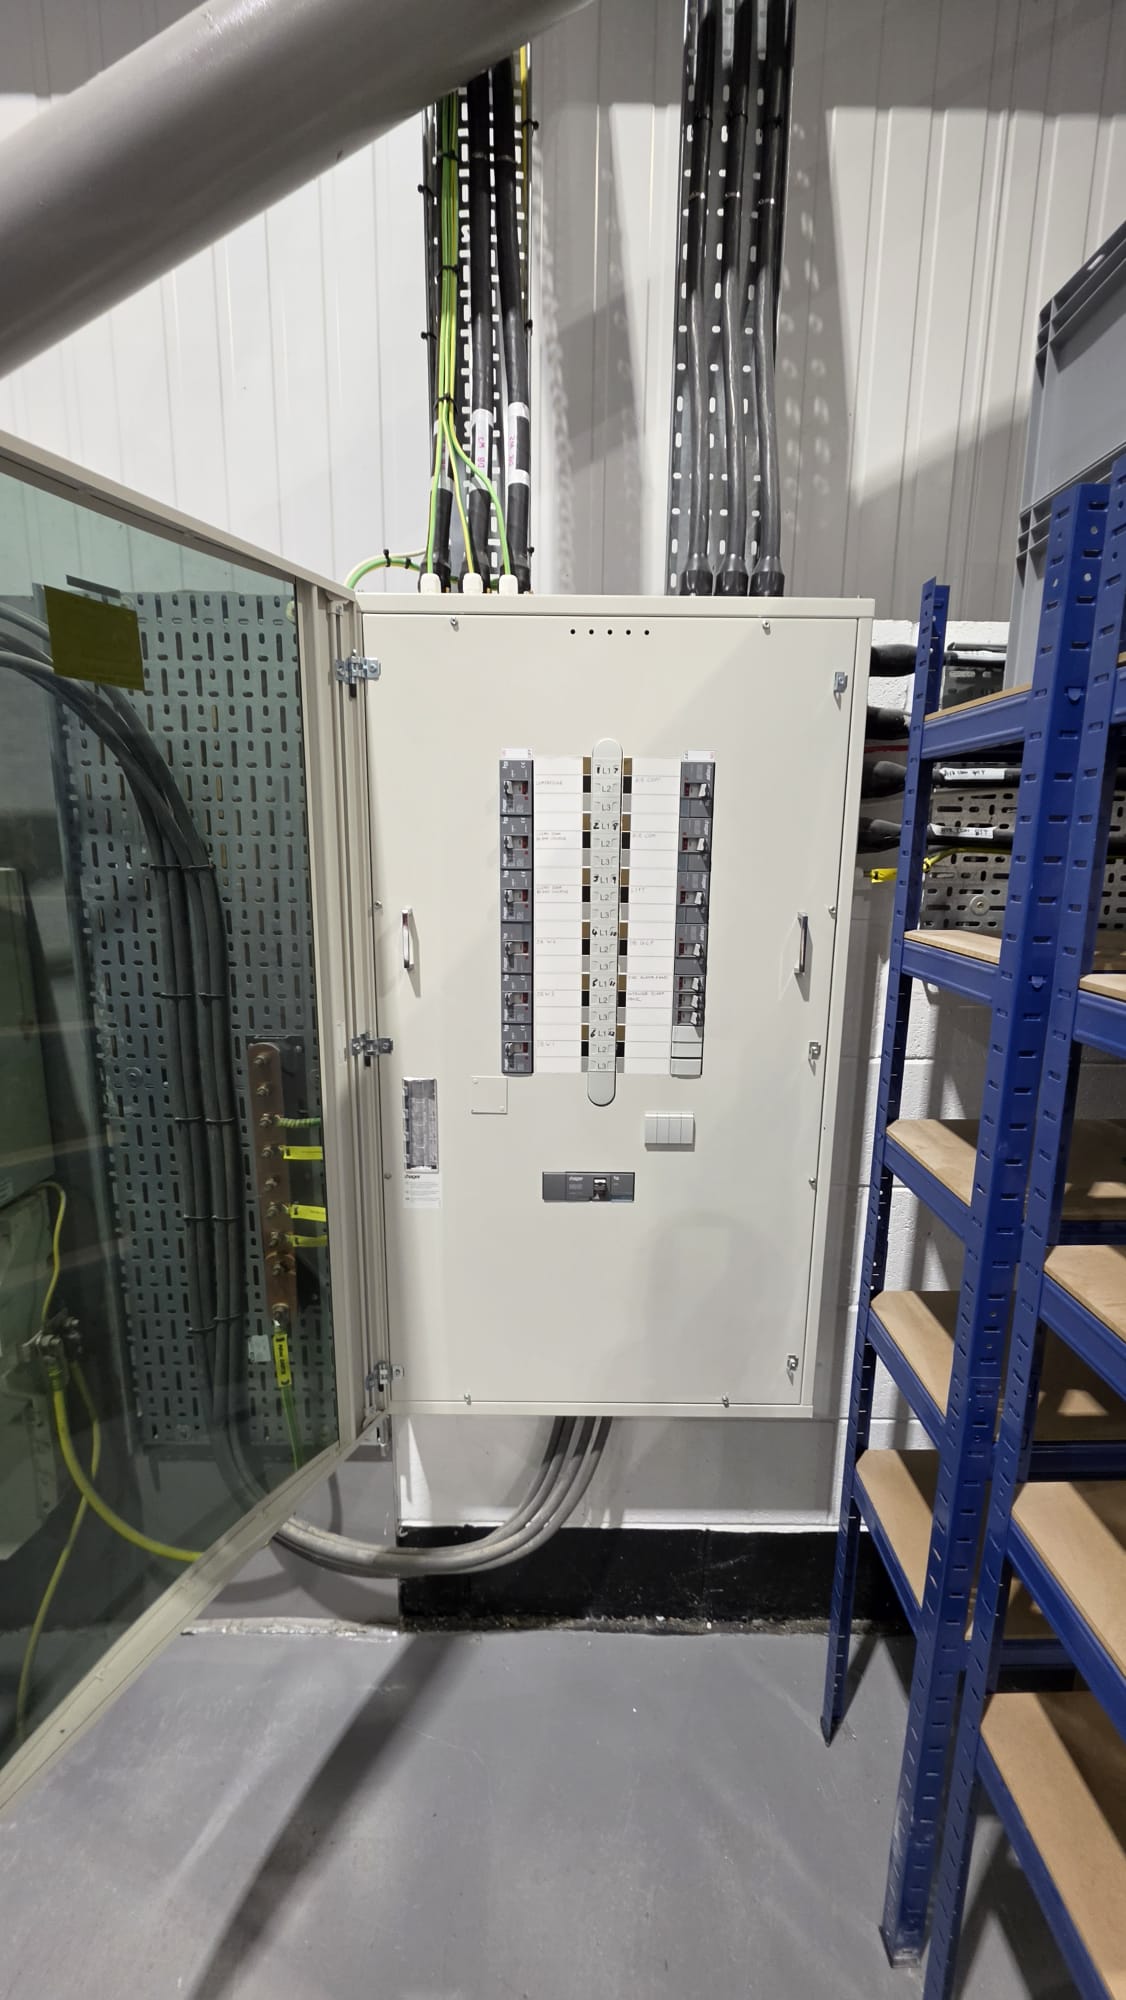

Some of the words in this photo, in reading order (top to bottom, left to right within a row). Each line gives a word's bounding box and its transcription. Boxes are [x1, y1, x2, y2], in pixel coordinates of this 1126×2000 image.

[602, 767, 611, 775] L1
[601, 785, 612, 793] L2
[601, 804, 611, 812] L3
[600, 840, 611, 848] L2
[600, 858, 610, 866] L3
[600, 876, 609, 884] L1
[600, 893, 609, 901] L2
[600, 911, 610, 919] L3
[600, 929, 608, 937] L1
[599, 945, 609, 953] L2
[600, 962, 609, 971] L3
[598, 1013, 608, 1021] L3
[597, 1045, 606, 1053] L2
[597, 1062, 606, 1070] L3
